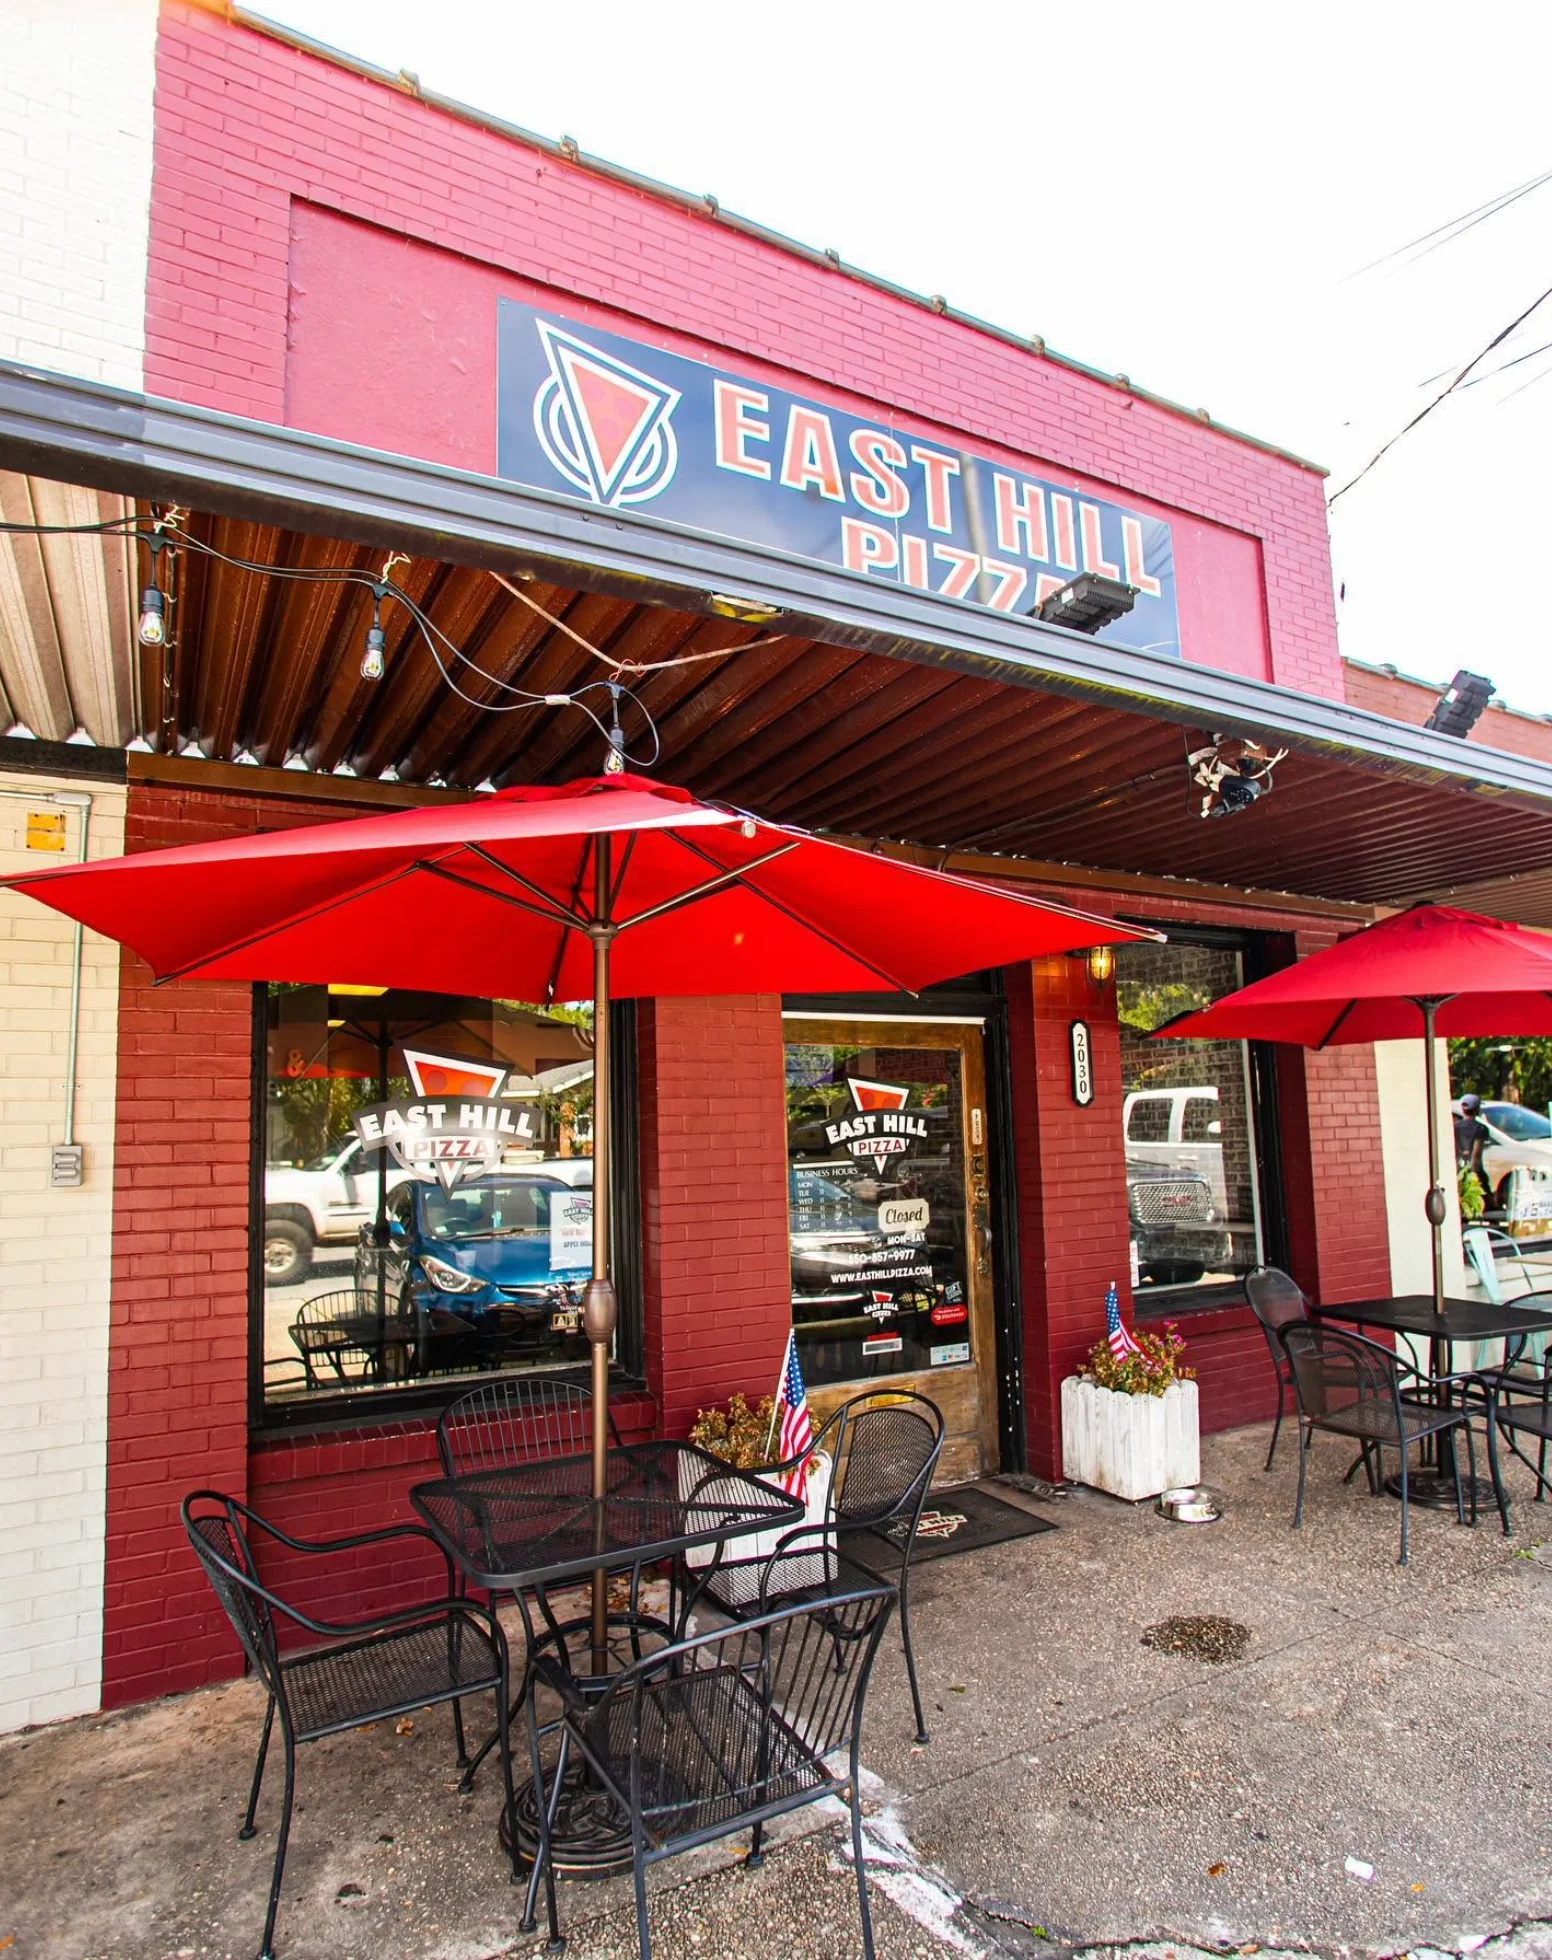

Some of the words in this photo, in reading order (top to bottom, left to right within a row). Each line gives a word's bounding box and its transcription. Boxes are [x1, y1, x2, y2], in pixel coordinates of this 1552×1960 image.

[713, 378, 961, 535] EAST
[993, 470, 1162, 598] HILL
[1077, 1033, 1087, 1094] 2030
[360, 1104, 446, 1142] EAST
[459, 1104, 534, 1139] HILL
[825, 1115, 876, 1144] EAST
[883, 1114, 928, 1137] HILL
[413, 1139, 490, 1158] PIZZA
[858, 1139, 903, 1154] PIZZA
[796, 1169, 830, 1179] BUSINESS
[832, 1167, 858, 1176] HOURS
[798, 1181, 813, 1189] MON
[799, 1214, 809, 1222] FRI
[885, 1206, 923, 1225] Closed
[887, 1232, 925, 1245] MON-SAT
[830, 1265, 933, 1284] WWW.EASTHILLPIZZA.COM
[863, 1303, 881, 1314] EAST
[883, 1302, 899, 1311] HILL
